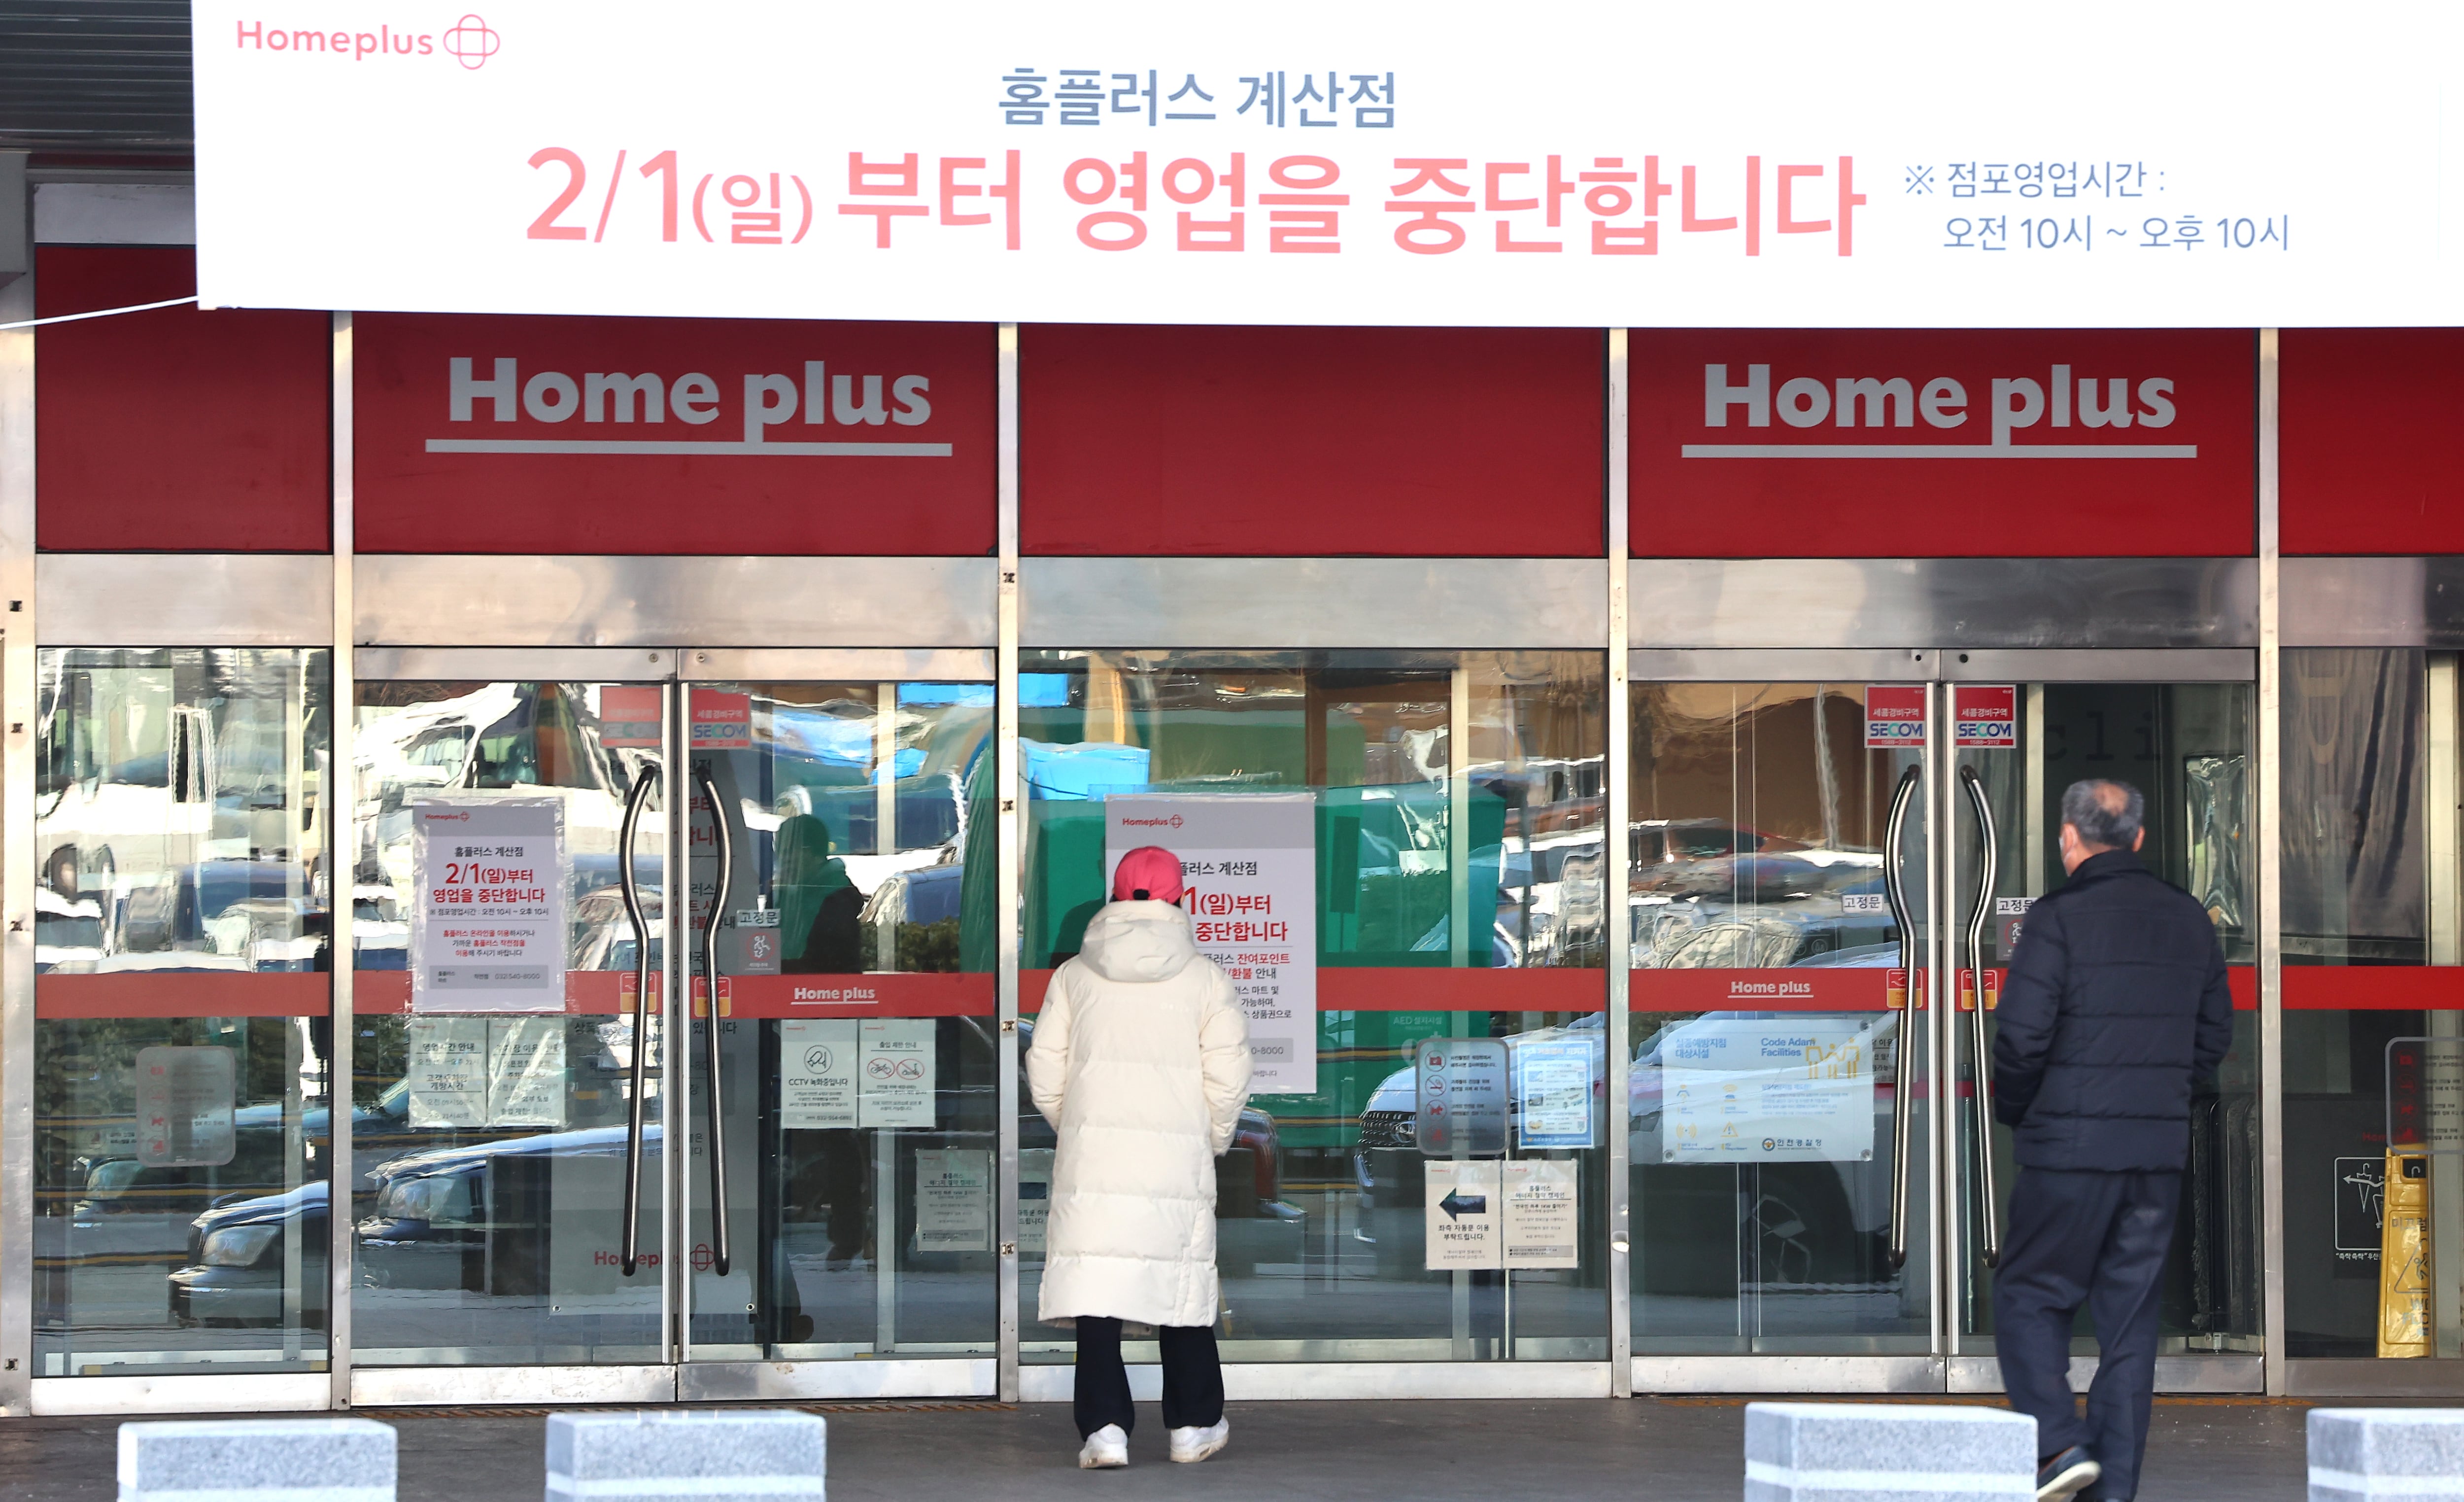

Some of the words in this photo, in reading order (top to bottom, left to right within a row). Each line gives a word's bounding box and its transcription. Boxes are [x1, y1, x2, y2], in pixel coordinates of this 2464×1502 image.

[236, 21, 434, 62] Homeplus
[998, 68, 1217, 127] 홈플러스
[1236, 70, 1397, 129] 계산점
[1947, 161, 2148, 198] 점포영업시간
[526, 147, 813, 245] 2/1(일)
[838, 149, 1021, 248] 부터
[1062, 150, 1352, 253] 영업을
[1385, 154, 1867, 256] 중단합니다
[1943, 214, 2007, 251] 오전
[2020, 214, 2091, 251] 10시
[2139, 214, 2205, 251] 오후
[2217, 214, 2289, 251] 10시
[449, 356, 719, 425] Home
[744, 360, 931, 443] plus
[1705, 364, 1968, 428] Home
[1991, 364, 2176, 446] plus
[694, 724, 746, 738] SECOM
[1870, 723, 1922, 737] SECOM
[1958, 723, 2011, 737] SECOM
[1123, 818, 1168, 827] Homeplus
[455, 846, 492, 857] 홈플러스
[495, 846, 523, 857] 계산점
[445, 863, 533, 884] 2/1(일)부터
[1180, 862, 1214, 875] 플러스
[1219, 862, 1258, 876] 계산점
[433, 888, 474, 903] 영업을
[478, 888, 545, 903] 중단합니다
[1183, 886, 1271, 916] 1(일)부터
[1844, 897, 1881, 909] 고정문
[740, 911, 777, 925] 고정문
[1196, 921, 1288, 942] 중단합니다
[1237, 953, 1290, 965] 잔여포인트
[1256, 968, 1276, 979] 안내
[794, 987, 840, 1000] Home
[843, 987, 875, 1002] plus
[1252, 986, 1268, 994] 마트
[1271, 986, 1279, 995] 및
[1731, 981, 1776, 993] Home
[1779, 981, 1810, 996] plus
[1393, 1016, 1413, 1025] AED
[1761, 1038, 1788, 1047] Code
[1790, 1038, 1815, 1047] Adam
[1676, 1048, 1709, 1059] 대상시설
[1761, 1048, 1802, 1057] Facilities
